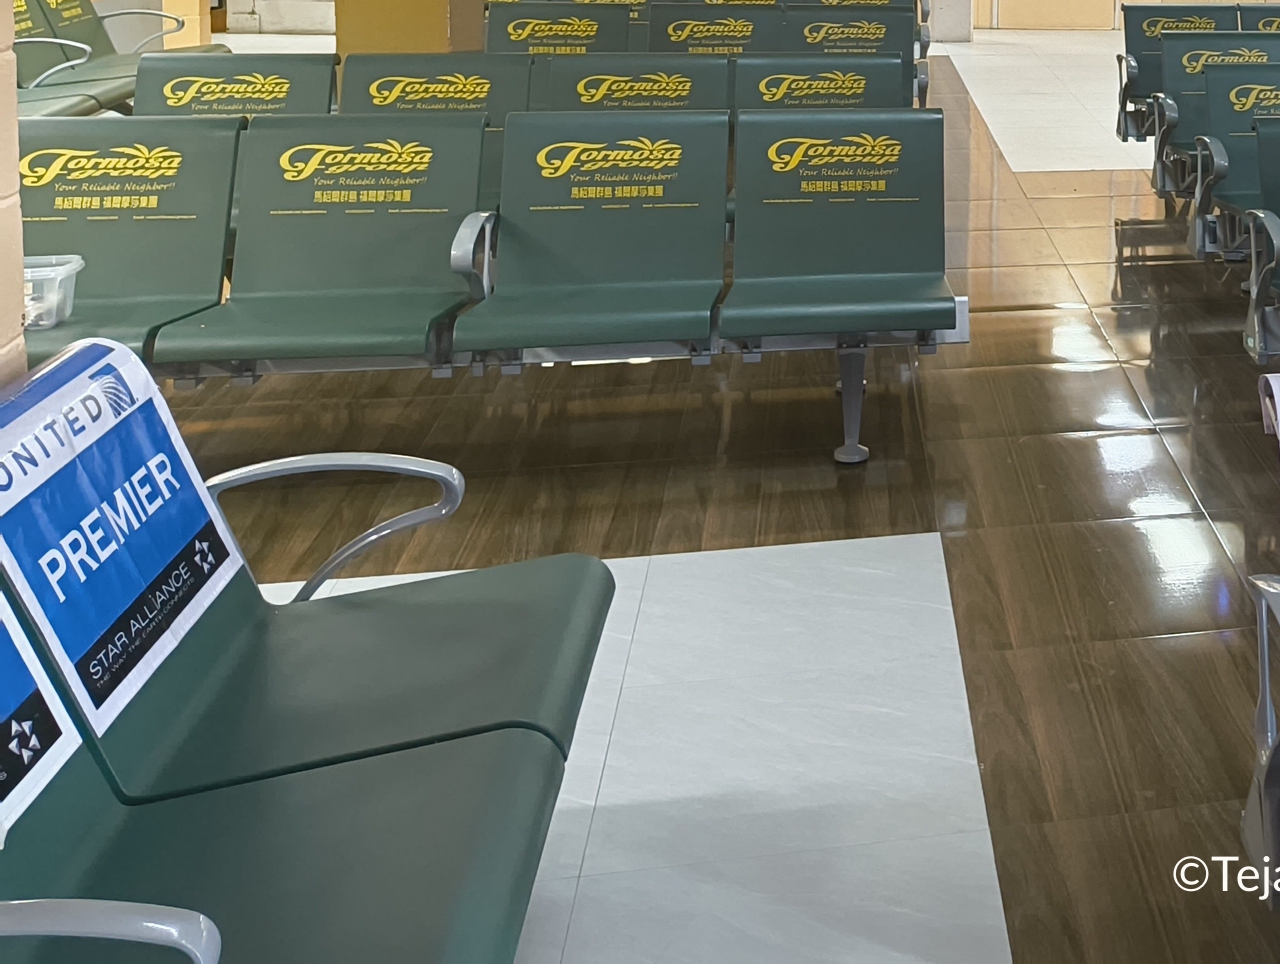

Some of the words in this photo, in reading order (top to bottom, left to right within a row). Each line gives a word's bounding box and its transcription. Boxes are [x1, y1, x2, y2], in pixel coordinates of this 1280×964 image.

[507, 21, 599, 42] Formosa
[667, 21, 754, 42] Formosa
[803, 21, 888, 44] Formosa
[1142, 17, 1216, 37] Formosa
[163, 76, 290, 107] Formosa
[369, 76, 491, 106] Formosa
[576, 78, 692, 103] Formosa
[759, 74, 866, 102] Formosa
[279, 143, 433, 181] Formosa
[536, 143, 682, 178] Formosa
[580, 160, 680, 172] group
[767, 138, 902, 173] Formosa
[808, 156, 900, 167] group
[19, 150, 182, 186] Formosa
[68, 169, 180, 180] group
[325, 161, 431, 174] group
[570, 172, 590, 183] Your
[594, 171, 629, 182] Reliable
[799, 167, 818, 178] Your
[821, 167, 853, 177] Reliable
[54, 182, 78, 192] Your
[81, 182, 121, 192] Reliable
[313, 176, 335, 187] Your
[338, 175, 375, 187] Reliable
[37, 451, 181, 605] PREMIER
[89, 631, 129, 680] STAR
[130, 561, 191, 638] ALLIANCE
